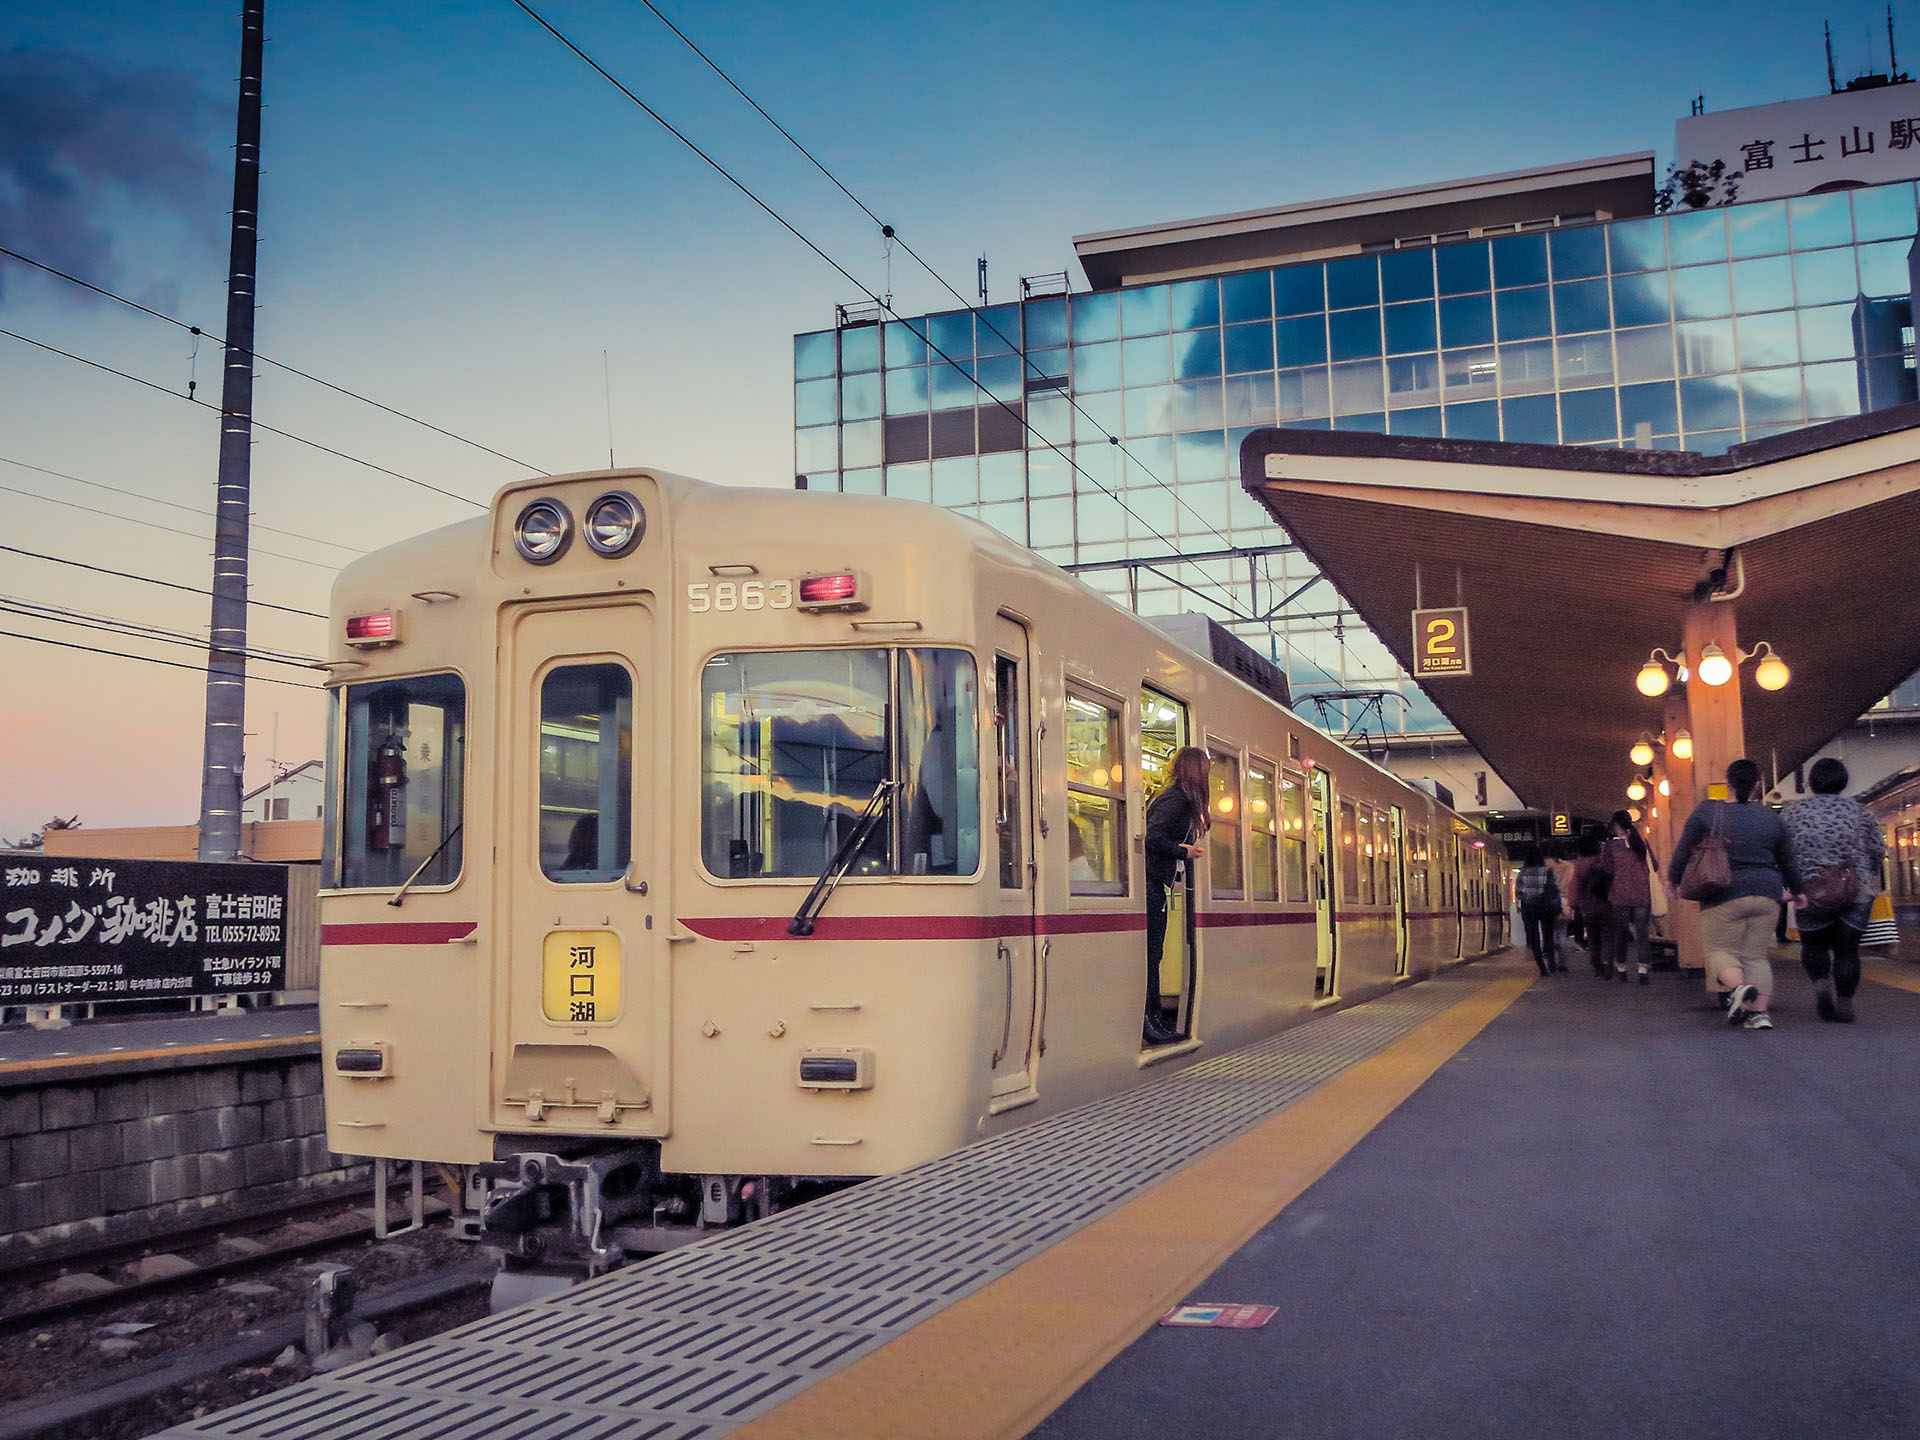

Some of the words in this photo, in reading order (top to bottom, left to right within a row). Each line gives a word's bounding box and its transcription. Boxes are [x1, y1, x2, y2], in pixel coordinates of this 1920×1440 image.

[1740, 117, 1920, 172] 富士山駅
[687, 580, 793, 612] 5863
[1427, 619, 1456, 654] 2
[1555, 815, 1567, 828] 2
[205, 893, 283, 920] 富士吉田店
[205, 925, 221, 943] TEL
[222, 925, 281, 942] 0555-72-8952
[569, 946, 597, 1022] 河口湖
